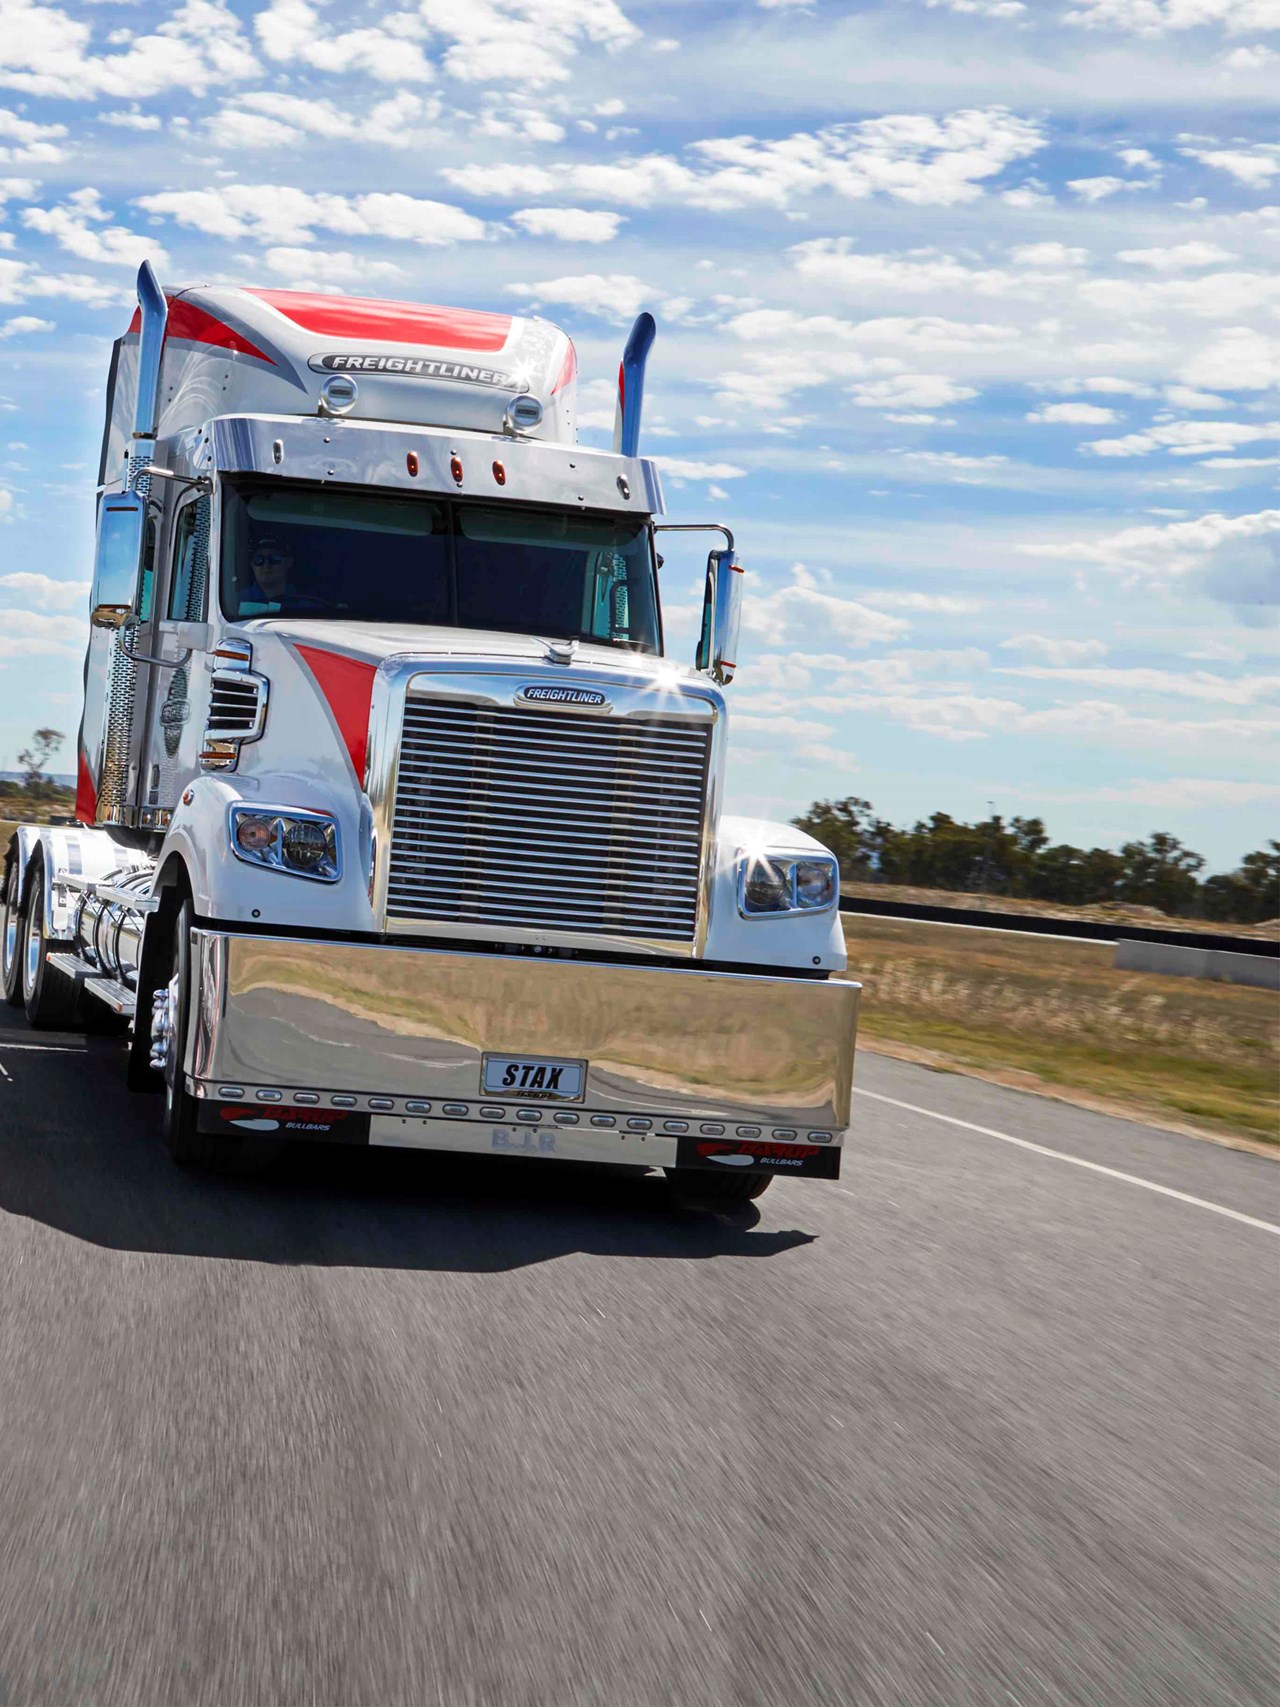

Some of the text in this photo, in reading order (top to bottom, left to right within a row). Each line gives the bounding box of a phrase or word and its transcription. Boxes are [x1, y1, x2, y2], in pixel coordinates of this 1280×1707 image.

[332, 356, 510, 386] FREIGHTLINER
[527, 688, 603, 704] FREIGHTLINER
[502, 1064, 564, 1090] STAX
[285, 1121, 332, 1131] BULLBARS
[760, 1157, 804, 1167] BULLBARS
